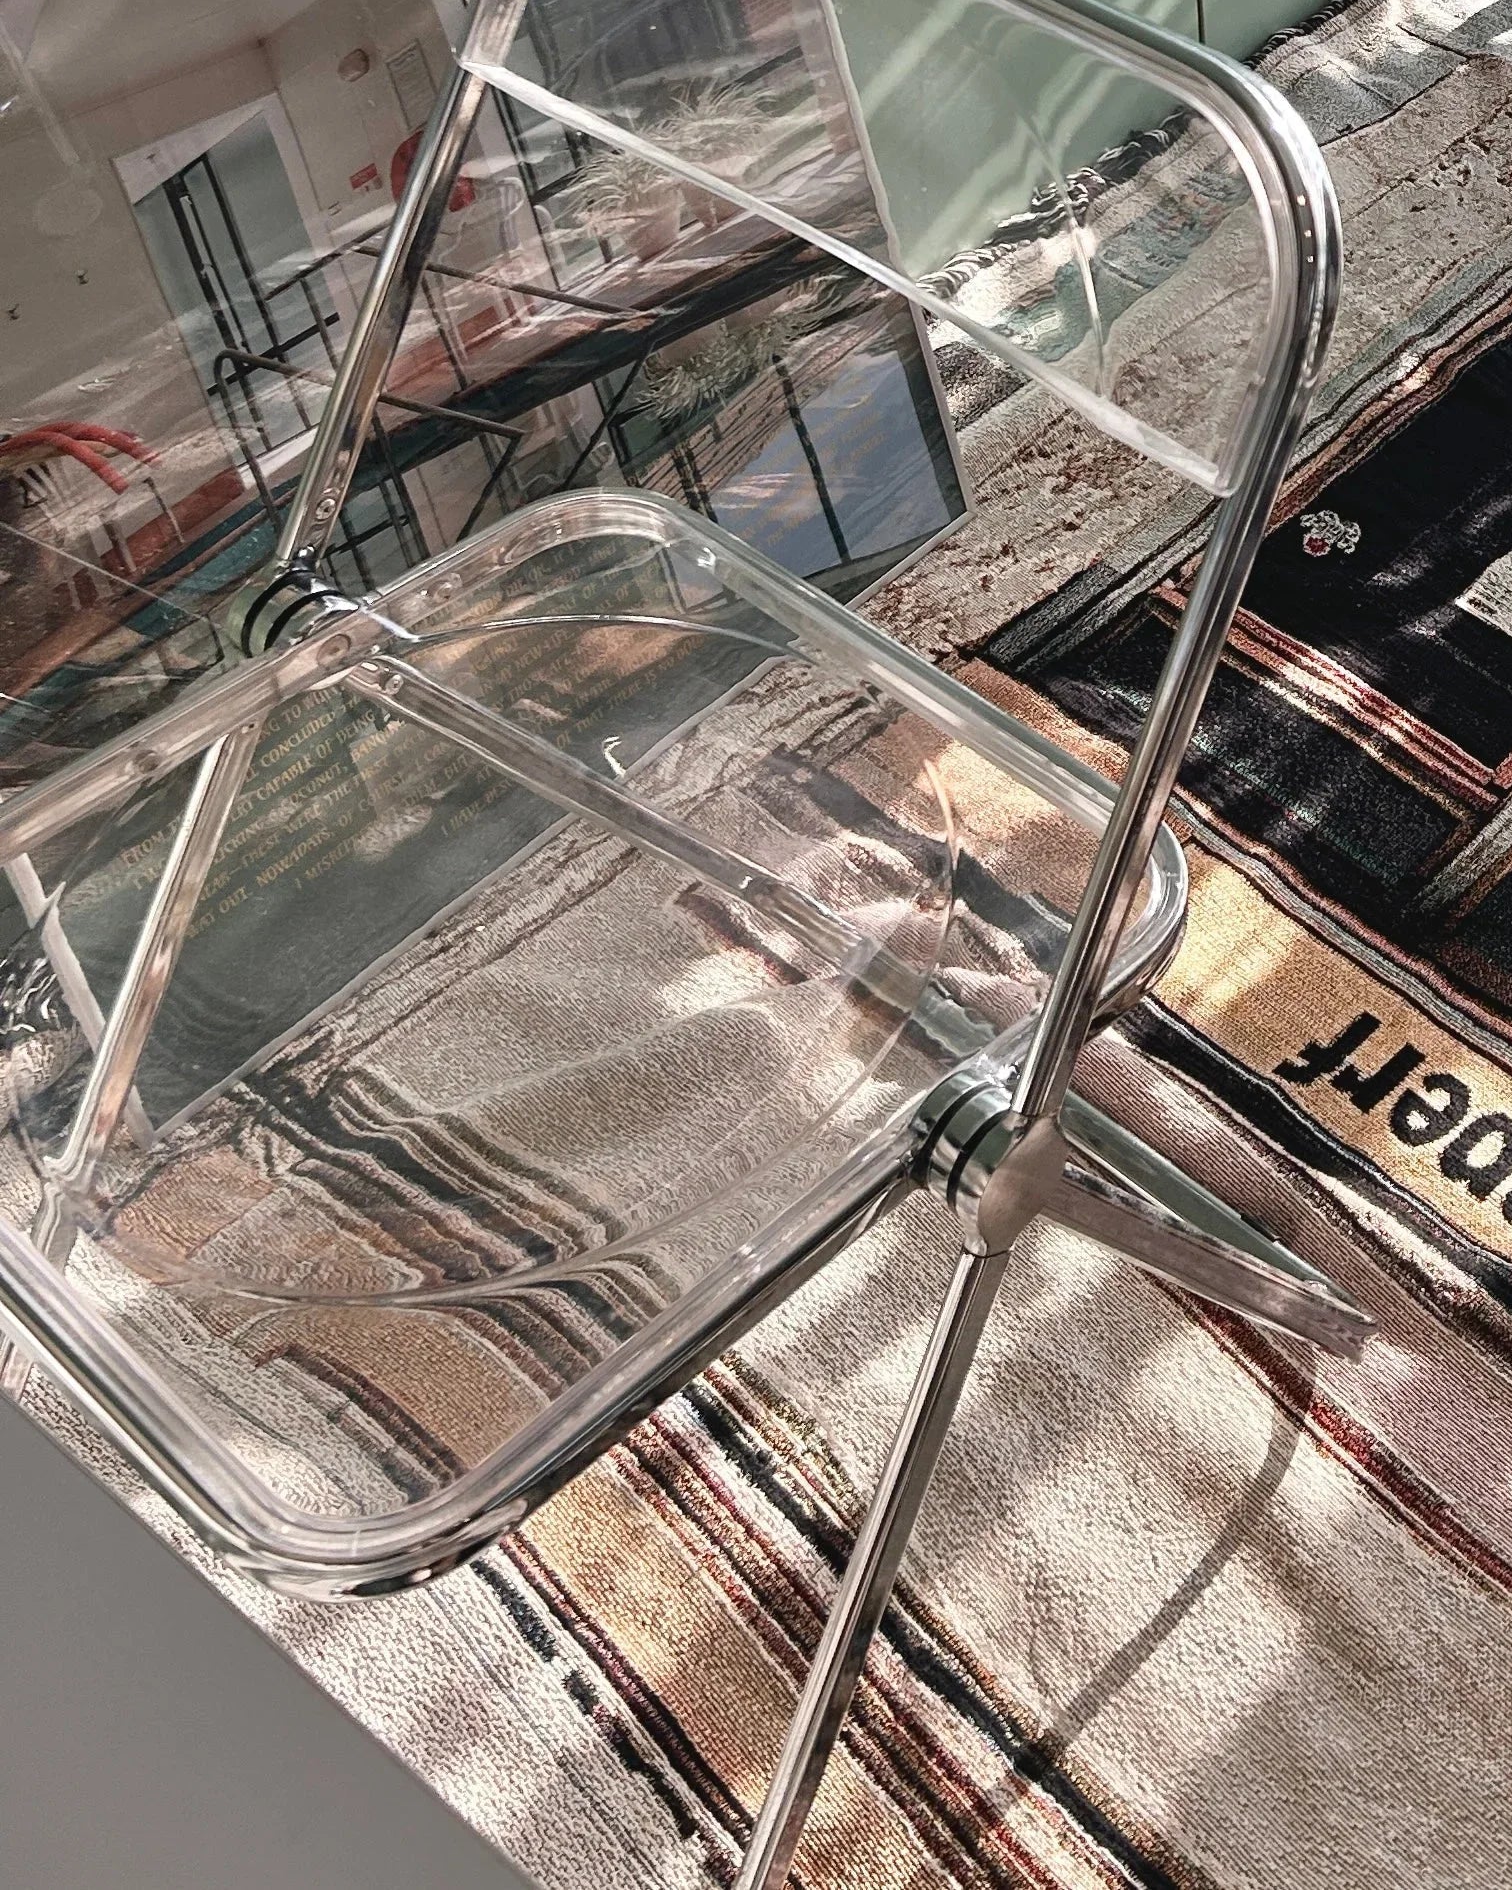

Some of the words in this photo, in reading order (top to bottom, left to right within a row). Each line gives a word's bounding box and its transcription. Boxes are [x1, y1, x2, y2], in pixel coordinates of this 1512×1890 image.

[255, 754, 313, 800] CAPABLE
[315, 738, 334, 759] OF
[260, 711, 336, 768] CONCLUDED
